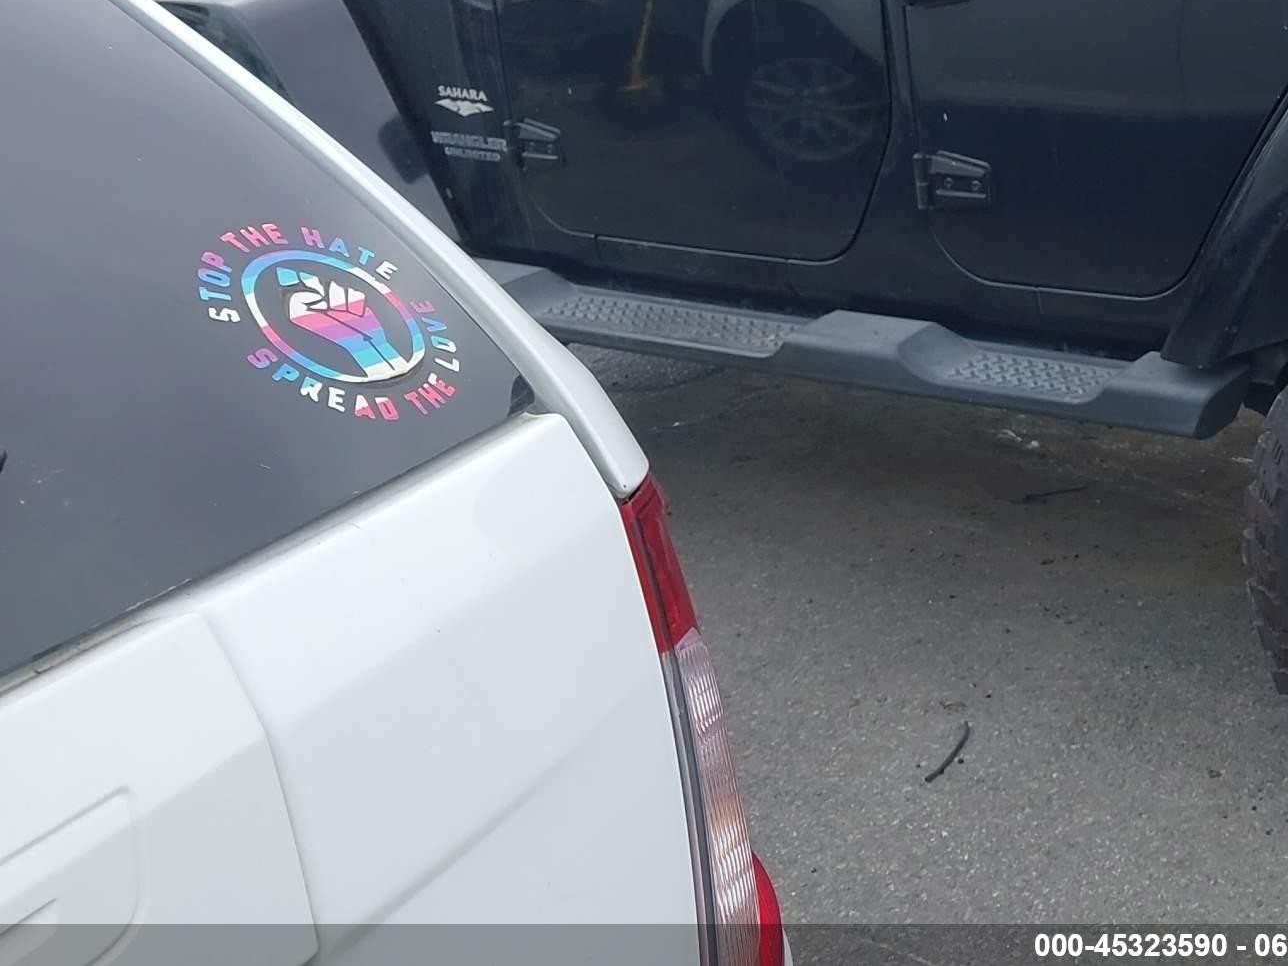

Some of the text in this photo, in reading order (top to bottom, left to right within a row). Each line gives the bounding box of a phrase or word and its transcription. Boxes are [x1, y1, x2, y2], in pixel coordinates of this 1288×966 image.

[437, 85, 488, 102] SAHARA
[196, 223, 399, 324] STOP THE HATE
[246, 300, 461, 421] SPREAD THE LOVE
